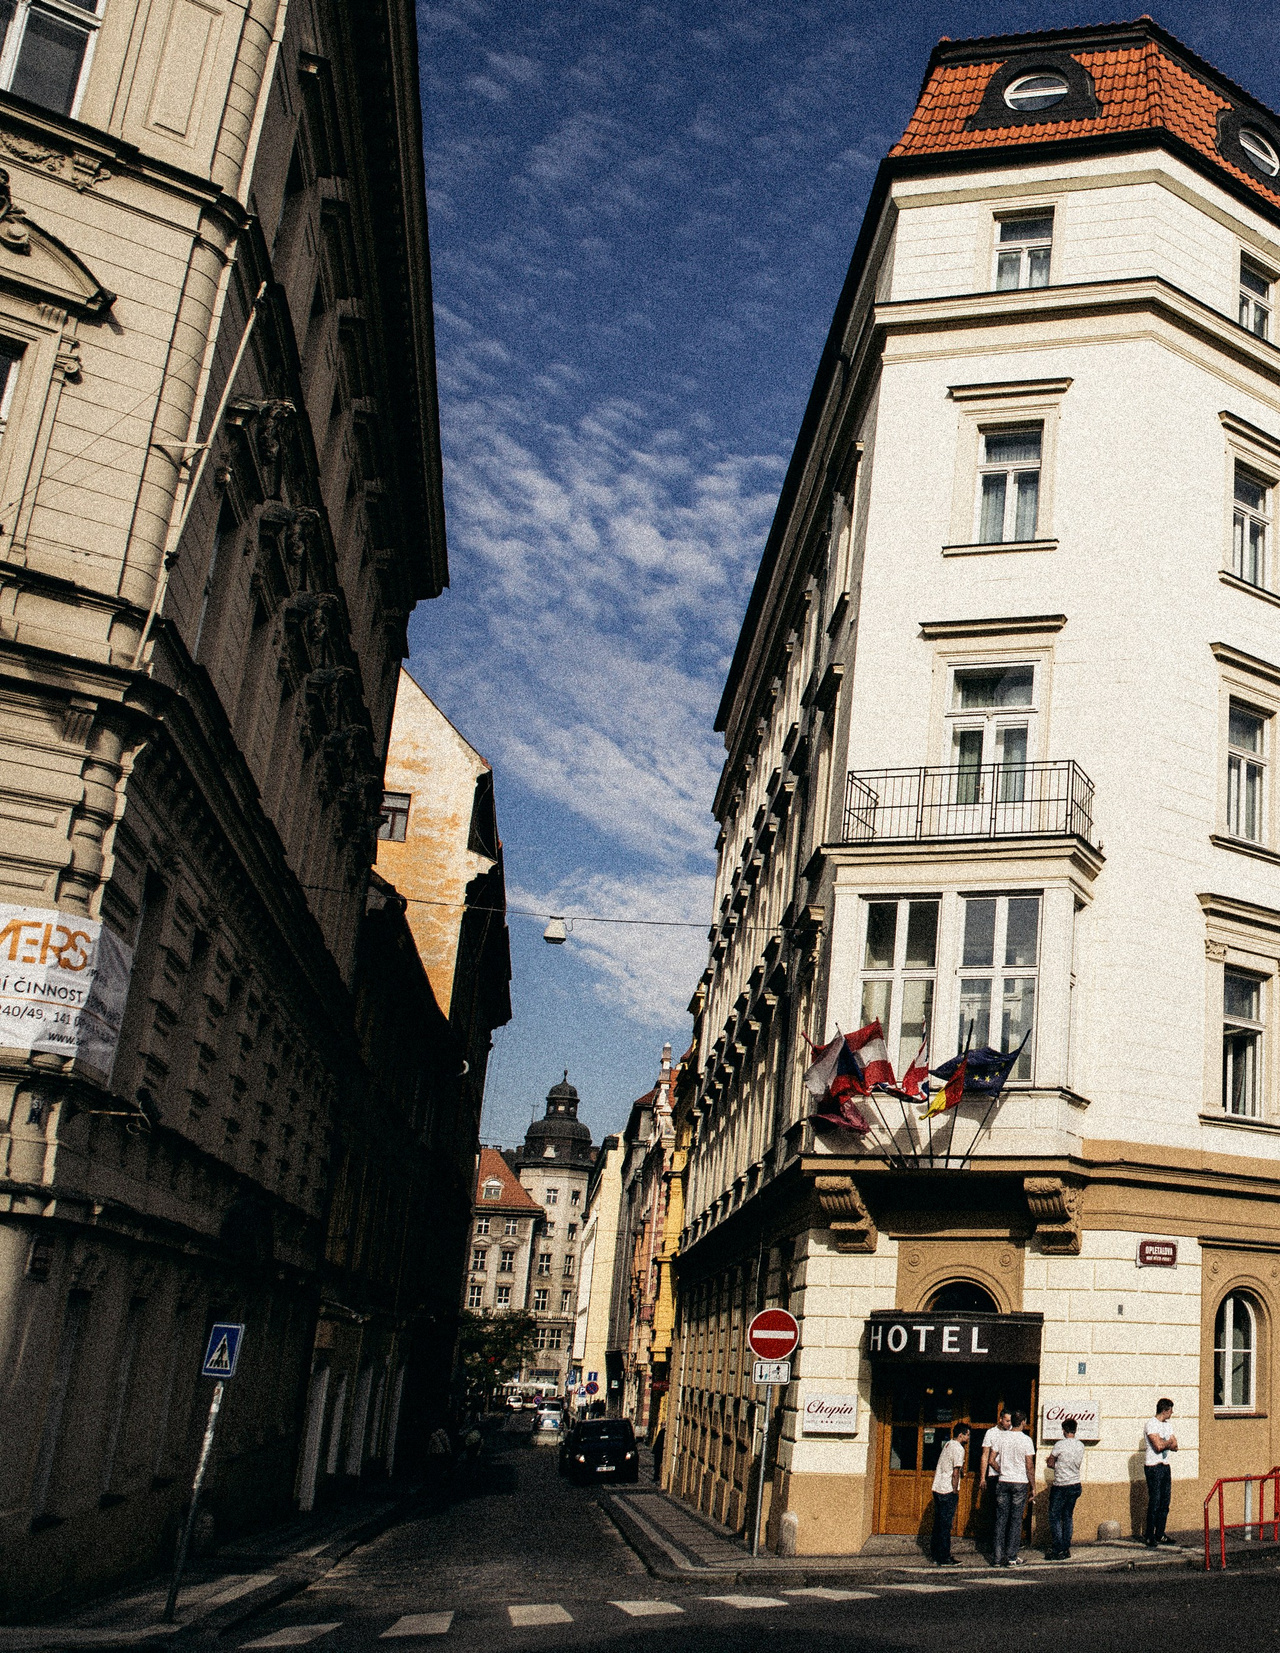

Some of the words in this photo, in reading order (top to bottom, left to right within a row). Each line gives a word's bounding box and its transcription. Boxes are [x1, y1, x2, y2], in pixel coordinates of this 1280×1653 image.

[13, 976, 84, 1003] ČINNOST
[54, 1011, 71, 1025] 141
[869, 1324, 989, 1354] HOTEL
[806, 1399, 853, 1419] Chopin
[1046, 1405, 1095, 1421] Chopin
